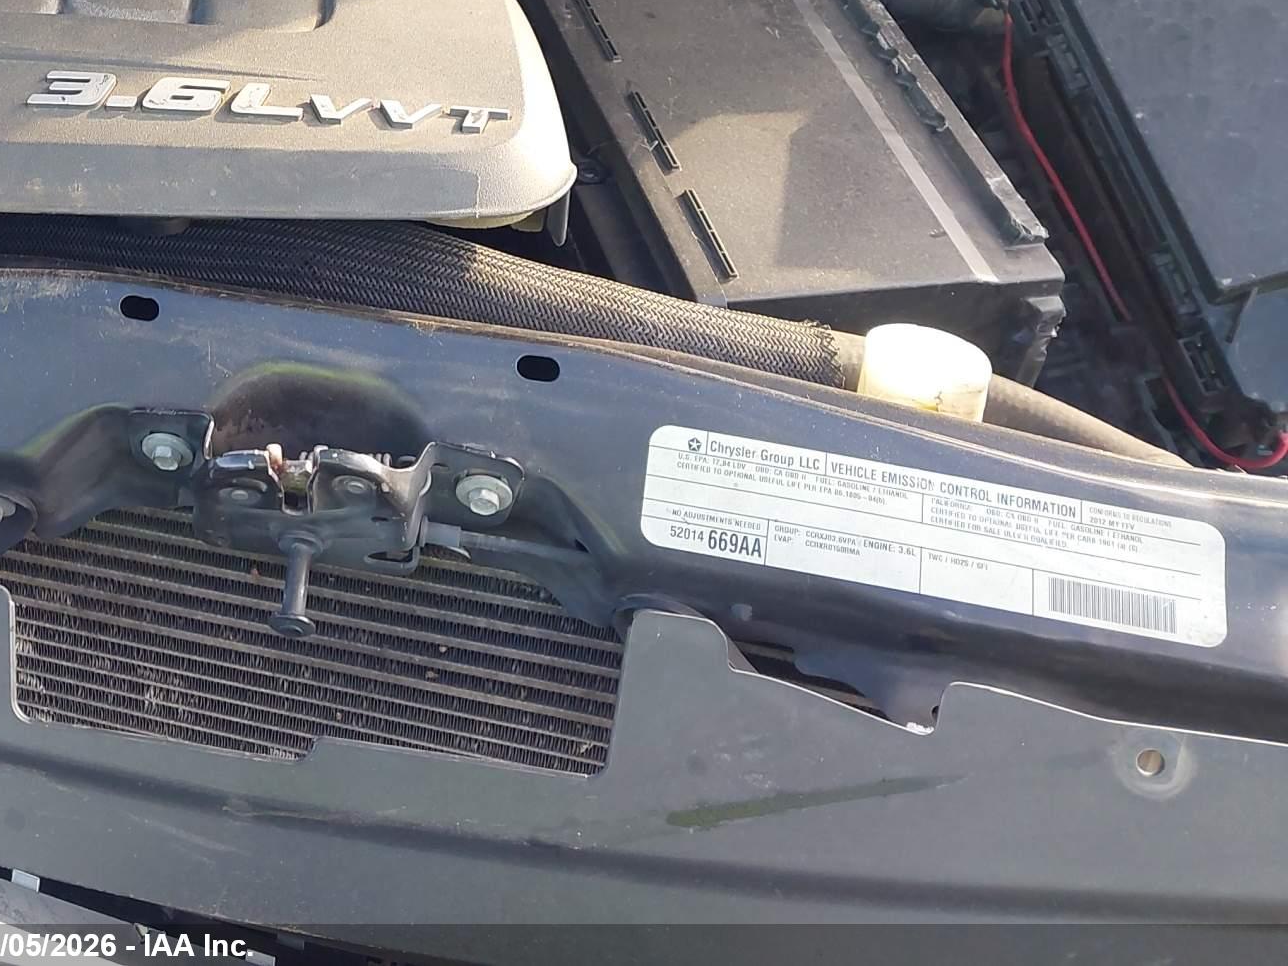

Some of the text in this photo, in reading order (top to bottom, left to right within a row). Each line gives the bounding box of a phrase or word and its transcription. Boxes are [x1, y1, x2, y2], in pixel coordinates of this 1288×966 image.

[25, 70, 304, 119] 3.6L
[709, 439, 820, 471] Chrysler Group LLC
[676, 460, 711, 473] CERTIFIED
[713, 466, 722, 475] TO
[723, 468, 757, 482] OPTIONAL
[758, 475, 784, 486] USEFUL
[831, 461, 1076, 518] VEHICLE EMISSION CONTROL INFORMATION
[836, 479, 870, 493] GASOLINE
[877, 487, 909, 499] ETHANOL
[683, 509, 732, 525] ADJUSTMENTS
[734, 518, 761, 531] NEEDED
[930, 506, 965, 520] CERTIFIED
[967, 513, 976, 521] TO
[930, 515, 965, 529] CERTIFIED
[1088, 515, 1106, 525] 2012
[669, 524, 762, 558] 52014 669AA
[1070, 523, 1104, 536] GASOLINE
[1111, 530, 1144, 544] ETHANOL
[862, 538, 915, 556] ENGINE: 3.6L
